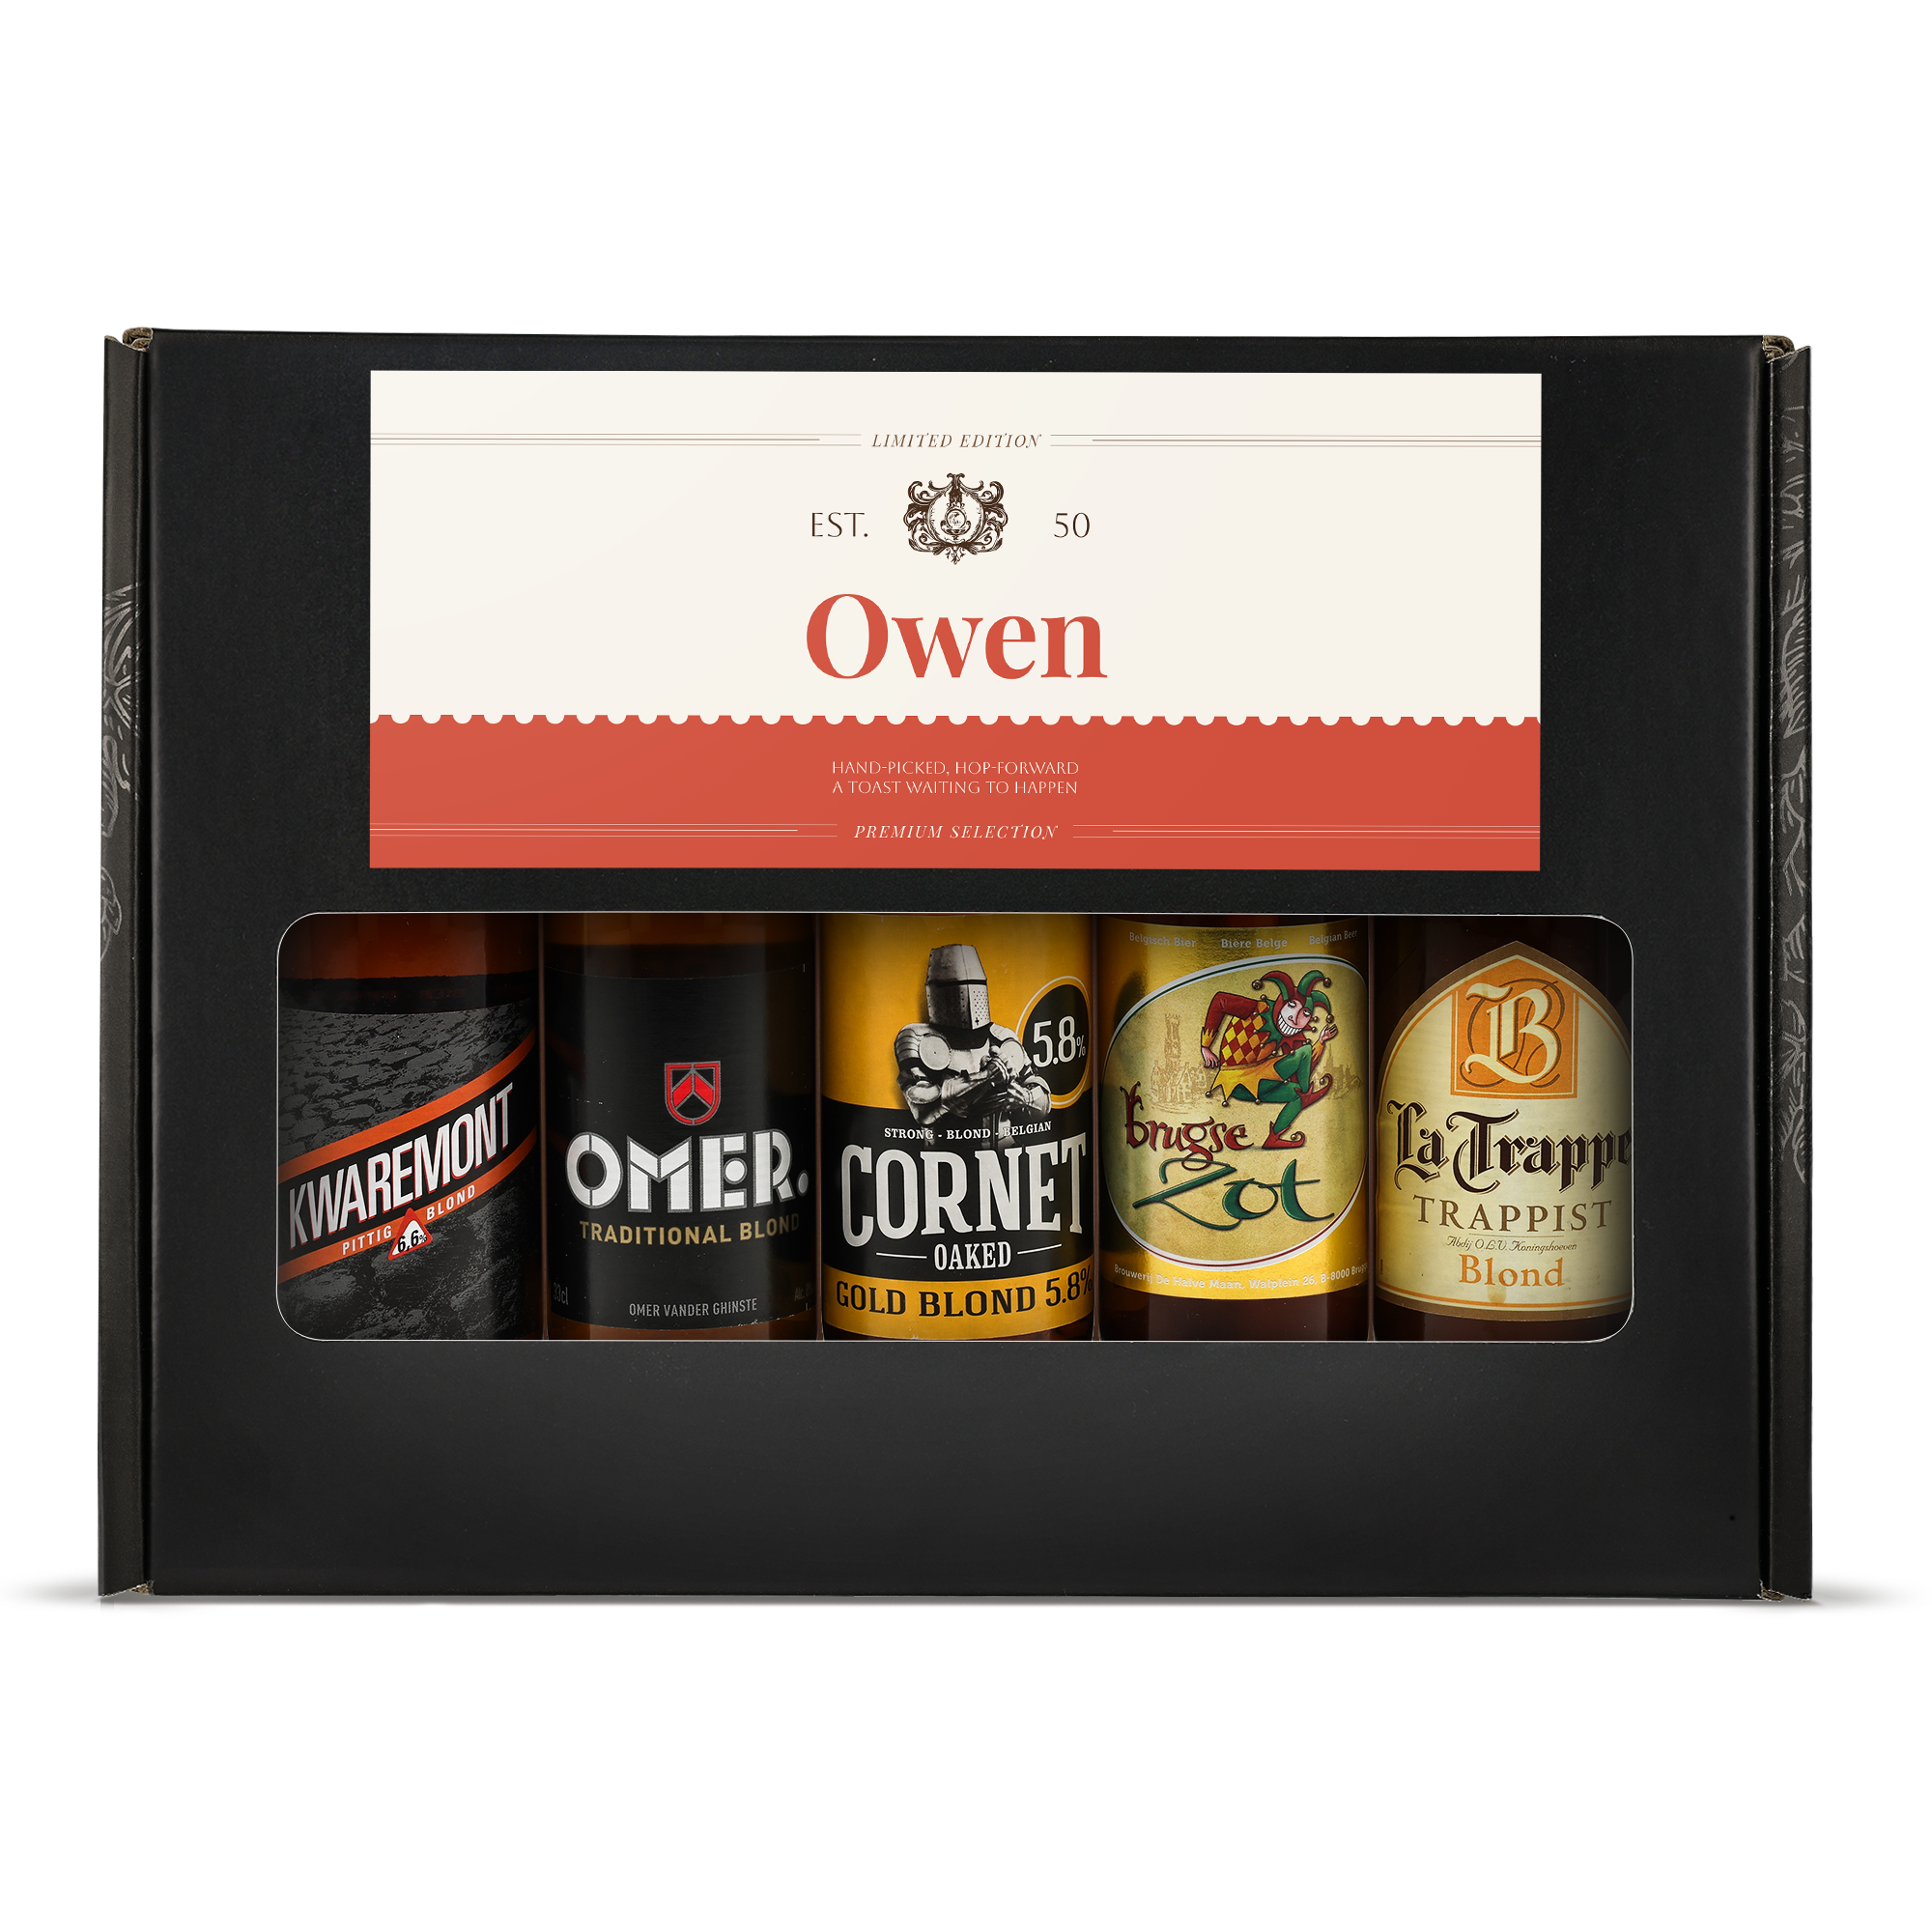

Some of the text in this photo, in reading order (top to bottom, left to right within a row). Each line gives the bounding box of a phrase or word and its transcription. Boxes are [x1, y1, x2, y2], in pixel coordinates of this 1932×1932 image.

[871, 434, 1041, 448] LIMITED EDITION
[811, 512, 1091, 538] EST. 50
[807, 593, 1107, 679] Owen
[832, 761, 1079, 776] HAND-PICKED, HOP-FORWARD
[832, 781, 1077, 794] A TOAST WAITING TO HAPPEN
[854, 824, 1058, 839] PREMIUM SELECTION
[1129, 932, 1196, 948] Belgisch Bier
[1221, 938, 1288, 949] Bière Belge
[1309, 929, 1357, 945] Belgian Beer
[1033, 1015, 1087, 1067] 5.8%
[1463, 980, 1563, 1087] B
[884, 1121, 1052, 1140] STRONG BLOND BELGIAN
[1387, 1099, 1632, 1195] La Trappe
[290, 1082, 513, 1250] KWAREMONT
[841, 1132, 1087, 1247] CORNET
[1132, 1157, 1335, 1231] Zot
[342, 1184, 476, 1256] PITTIG BLOND
[1412, 1194, 1612, 1232] TRAPPIST
[397, 1230, 428, 1253] 6,6%
[580, 1213, 800, 1245] TRADITIONAL BLOND
[934, 1241, 1011, 1270] OAKED
[1446, 1236, 1473, 1251] Abdij
[1509, 1239, 1577, 1255] Koningshoeven
[1115, 1264, 1153, 1284] Brouwerij
[1155, 1273, 1170, 1285] De
[1173, 1276, 1206, 1288] Halve
[1208, 1279, 1245, 1290] Maan,
[1249, 1278, 1299, 1290] Walplein
[1302, 1275, 1318, 1285] 26,
[1321, 1267, 1350, 1283] B-8000
[1459, 1253, 1565, 1288] Blond
[553, 1282, 569, 1305] 33cl
[837, 1264, 1092, 1317] GOLD BLOND 5.8%
[629, 1298, 757, 1317] OMER VANDER GHINSTE
